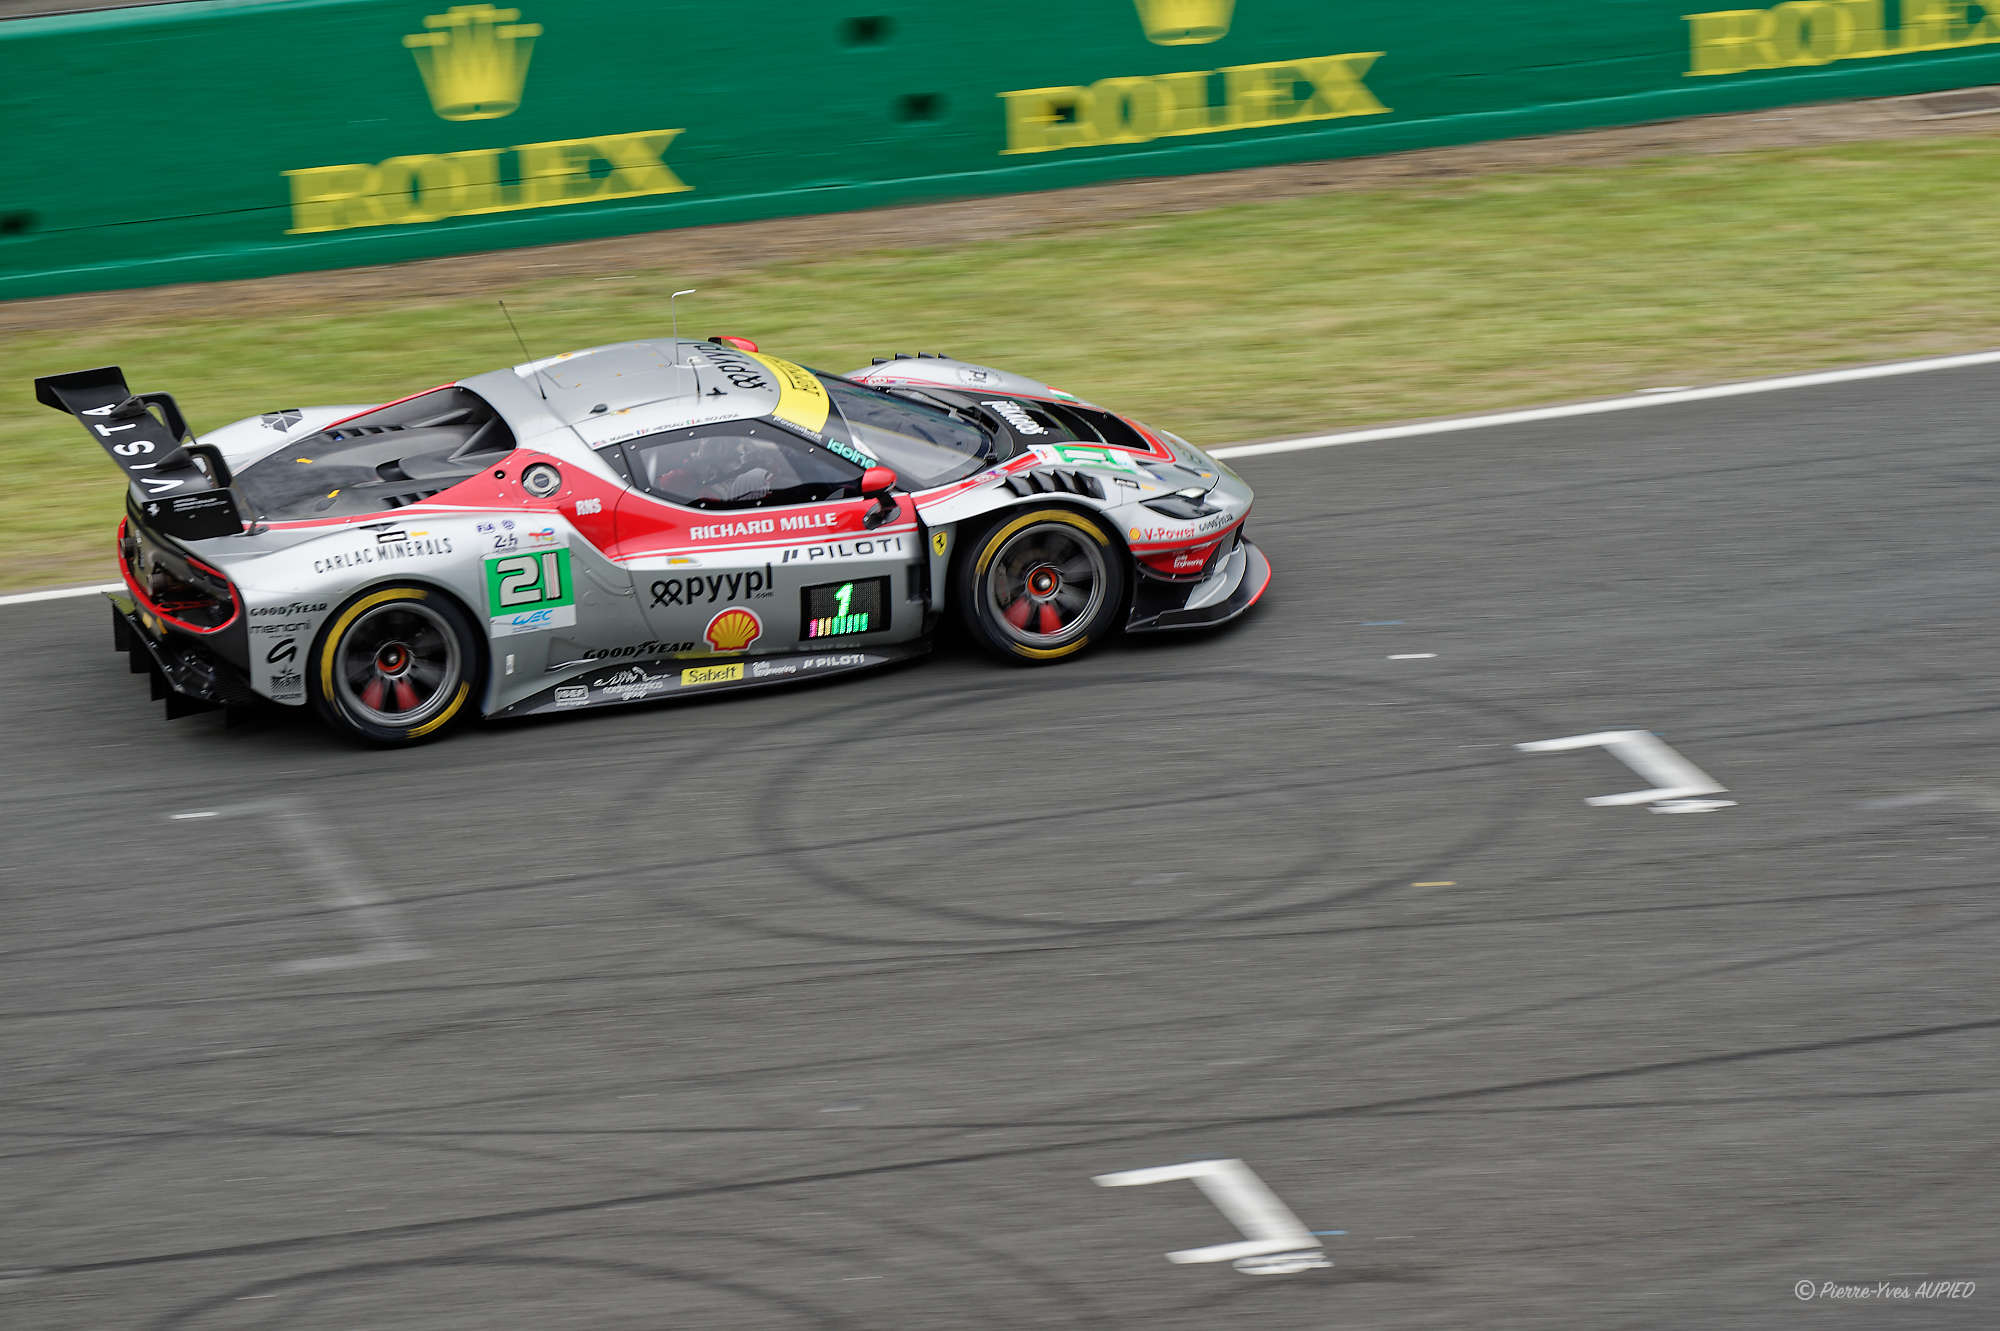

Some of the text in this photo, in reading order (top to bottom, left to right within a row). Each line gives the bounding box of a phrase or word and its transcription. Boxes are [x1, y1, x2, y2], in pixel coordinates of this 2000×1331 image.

[996, 51, 1393, 155] ROLEX
[280, 128, 696, 234] ROLEX
[81, 403, 185, 493] VISTA
[690, 512, 838, 541] RICHARD MILLE
[1145, 527, 1196, 541] V-Power
[314, 537, 453, 574] CARLAC MINERALS
[808, 536, 902, 561] PILOTI
[496, 551, 562, 608] 21
[686, 562, 772, 605] pyypl
[249, 602, 328, 617] GOODYEAR
[834, 582, 853, 617] 1
[512, 609, 553, 625] WEC
[583, 640, 695, 660] GOODYEAR
[816, 653, 865, 668] PILOTI
